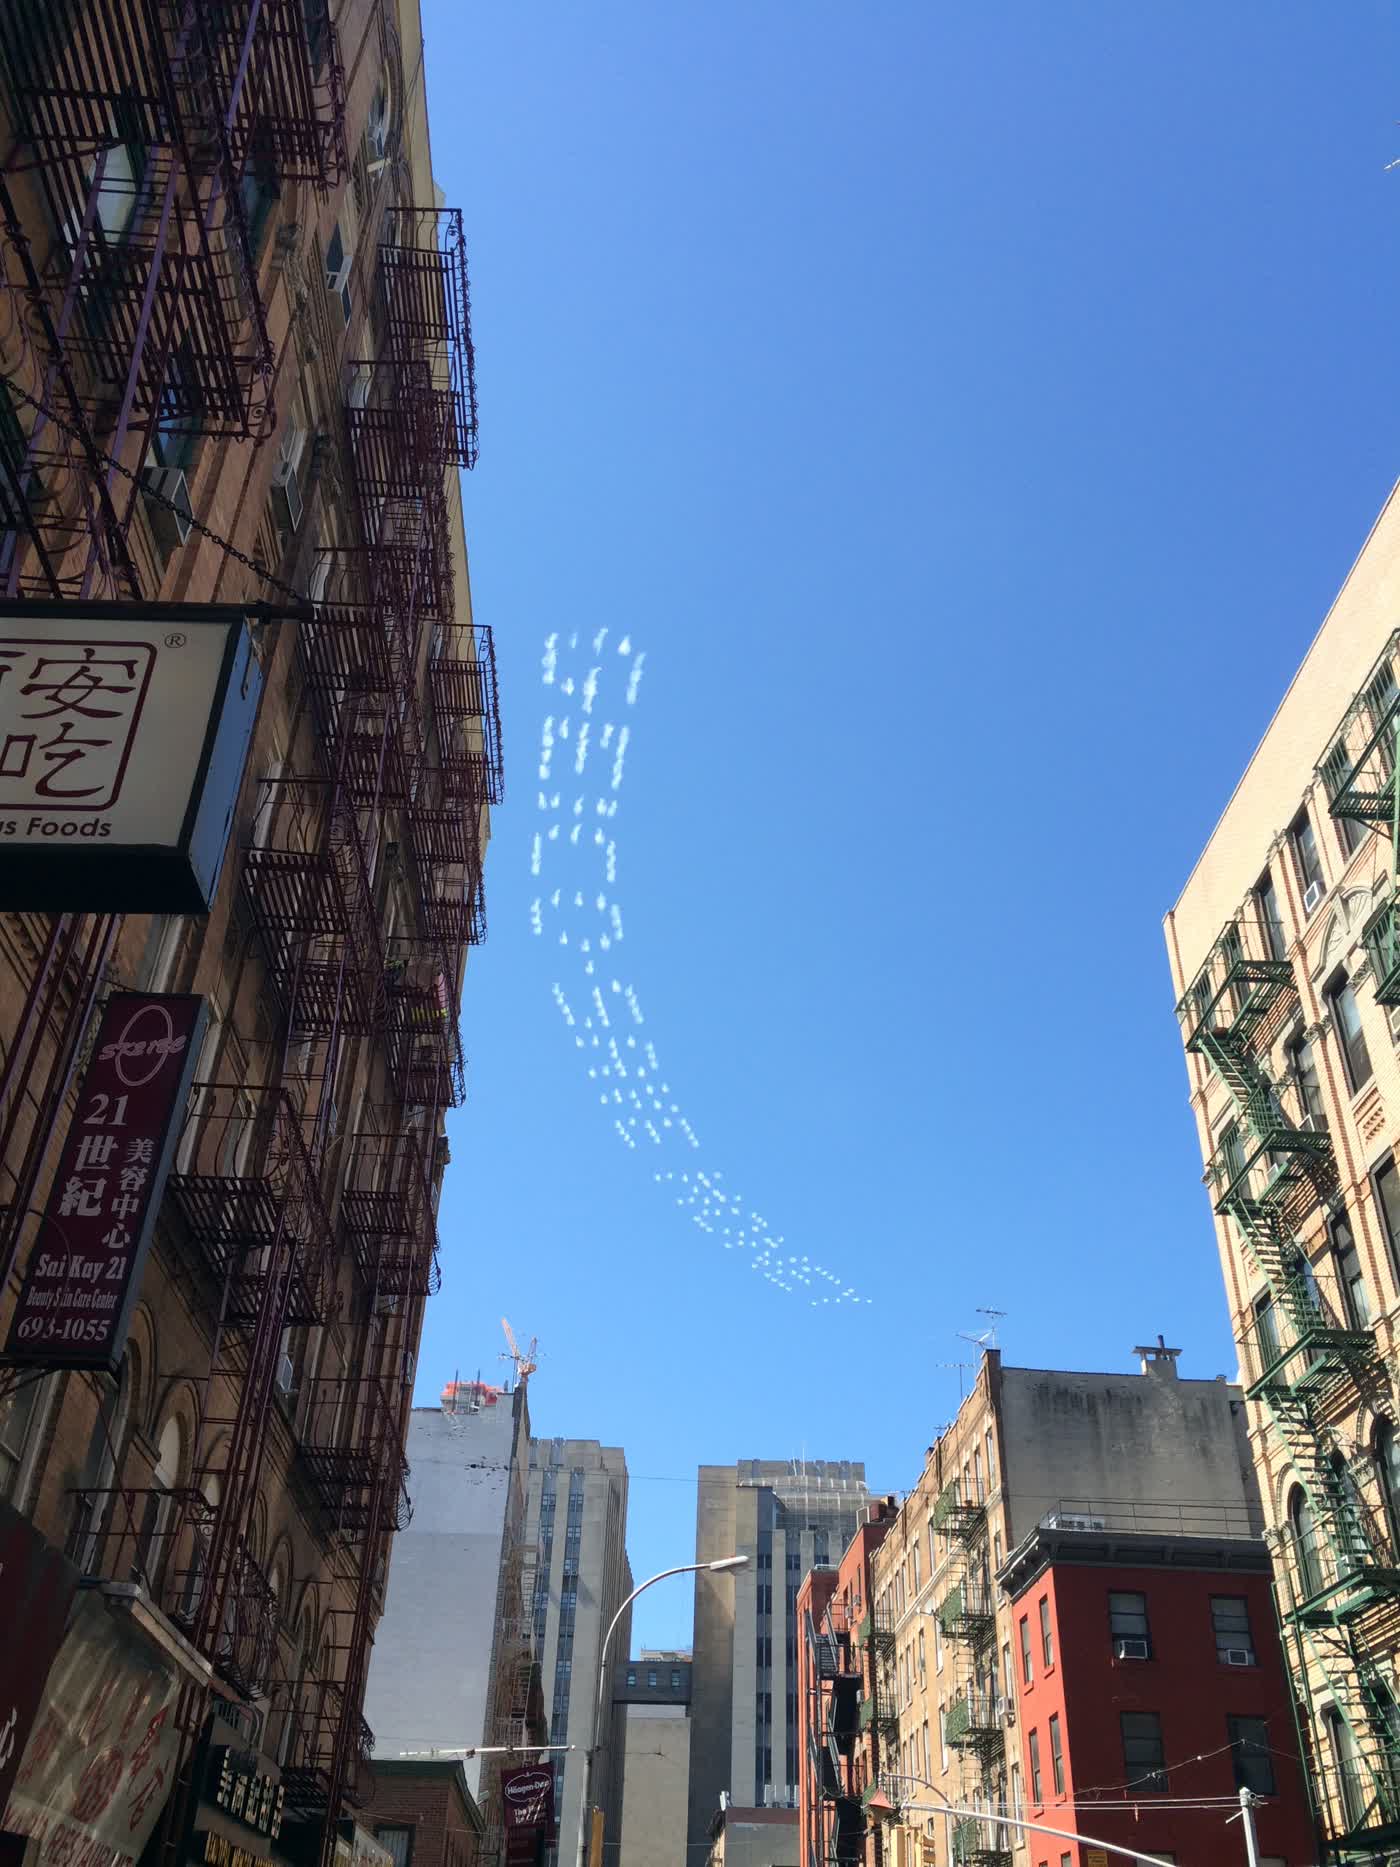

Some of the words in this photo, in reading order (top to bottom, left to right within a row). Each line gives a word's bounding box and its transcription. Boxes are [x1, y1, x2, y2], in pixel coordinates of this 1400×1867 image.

[26, 818, 113, 837] Foods
[83, 1094, 130, 1126] 21
[58, 1135, 119, 1217] 世紀
[100, 1137, 155, 1249] 美容中心
[35, 1254, 67, 1277] Sai
[68, 1256, 104, 1283] Kay
[105, 1256, 127, 1280] 21
[53, 1288, 73, 1307] Sin
[17, 1317, 113, 1341] 693-1055
